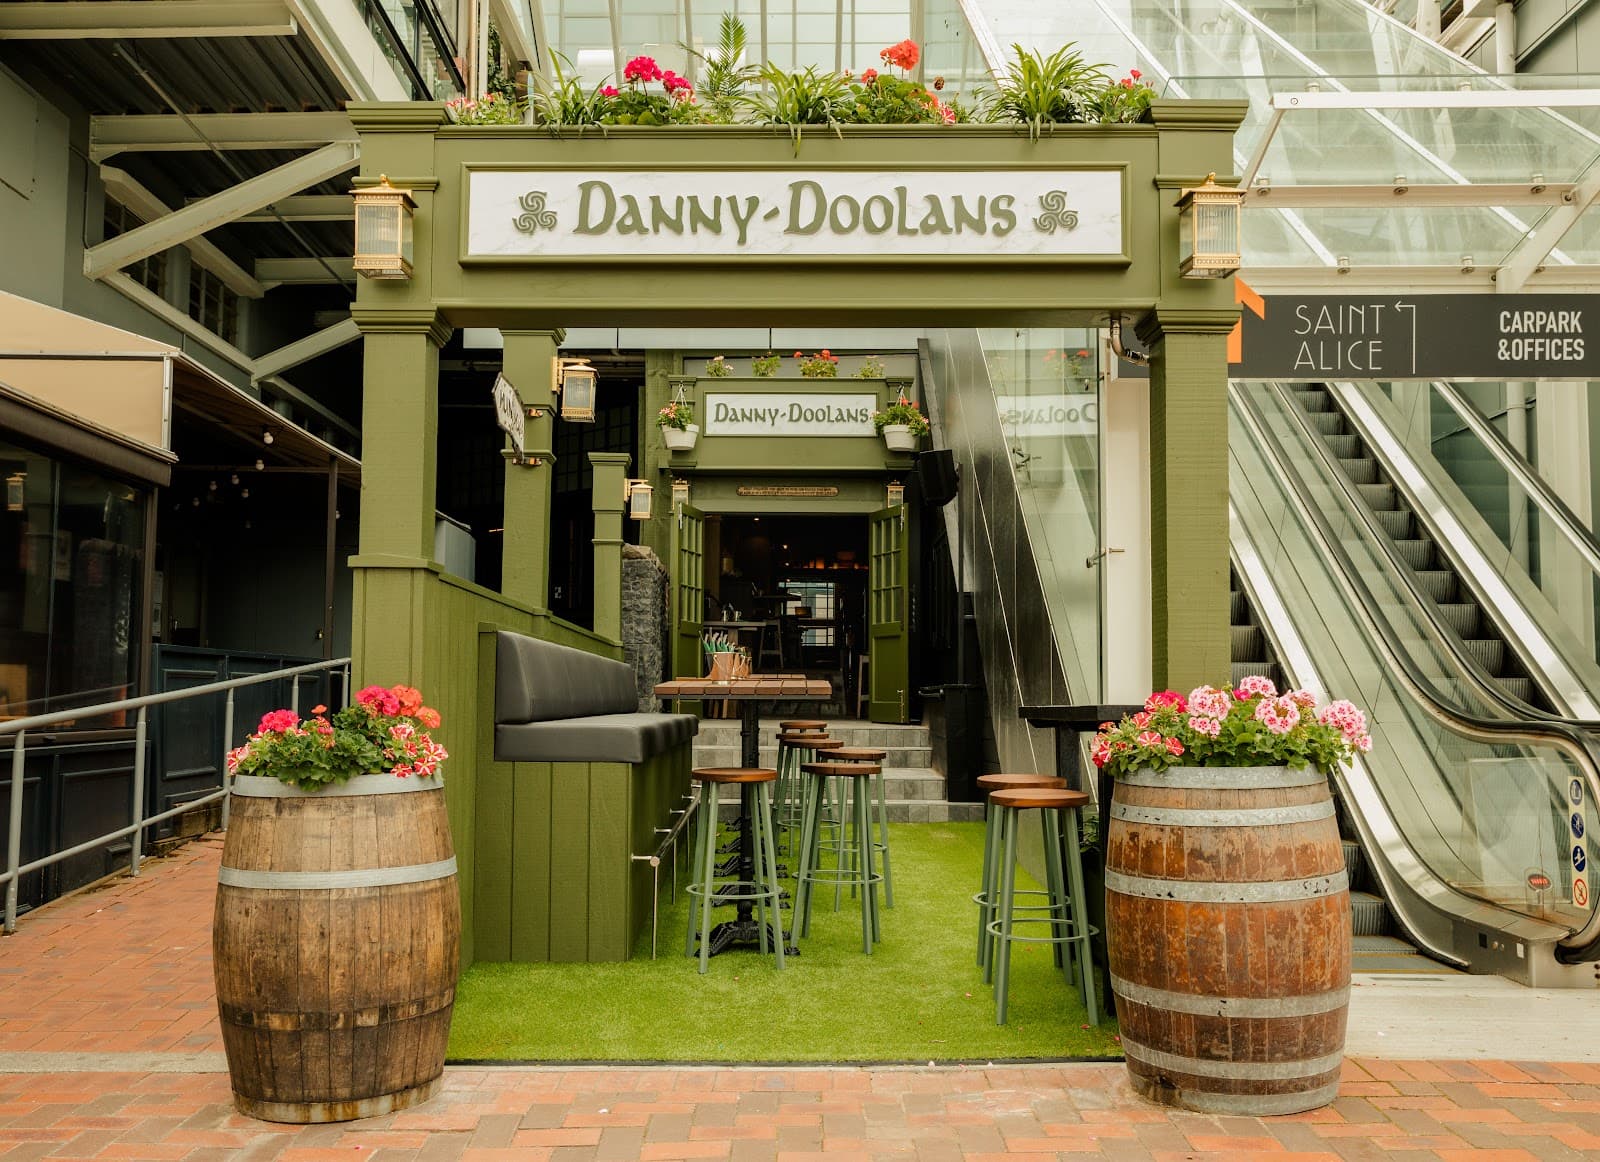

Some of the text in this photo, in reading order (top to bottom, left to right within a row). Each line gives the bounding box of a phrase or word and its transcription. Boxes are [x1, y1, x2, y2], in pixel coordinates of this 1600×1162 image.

[1293, 304, 1386, 335] SAINT
[1499, 310, 1583, 334] CARPARK
[1293, 340, 1383, 370] ALICE
[1497, 338, 1585, 361] &OFFICES
